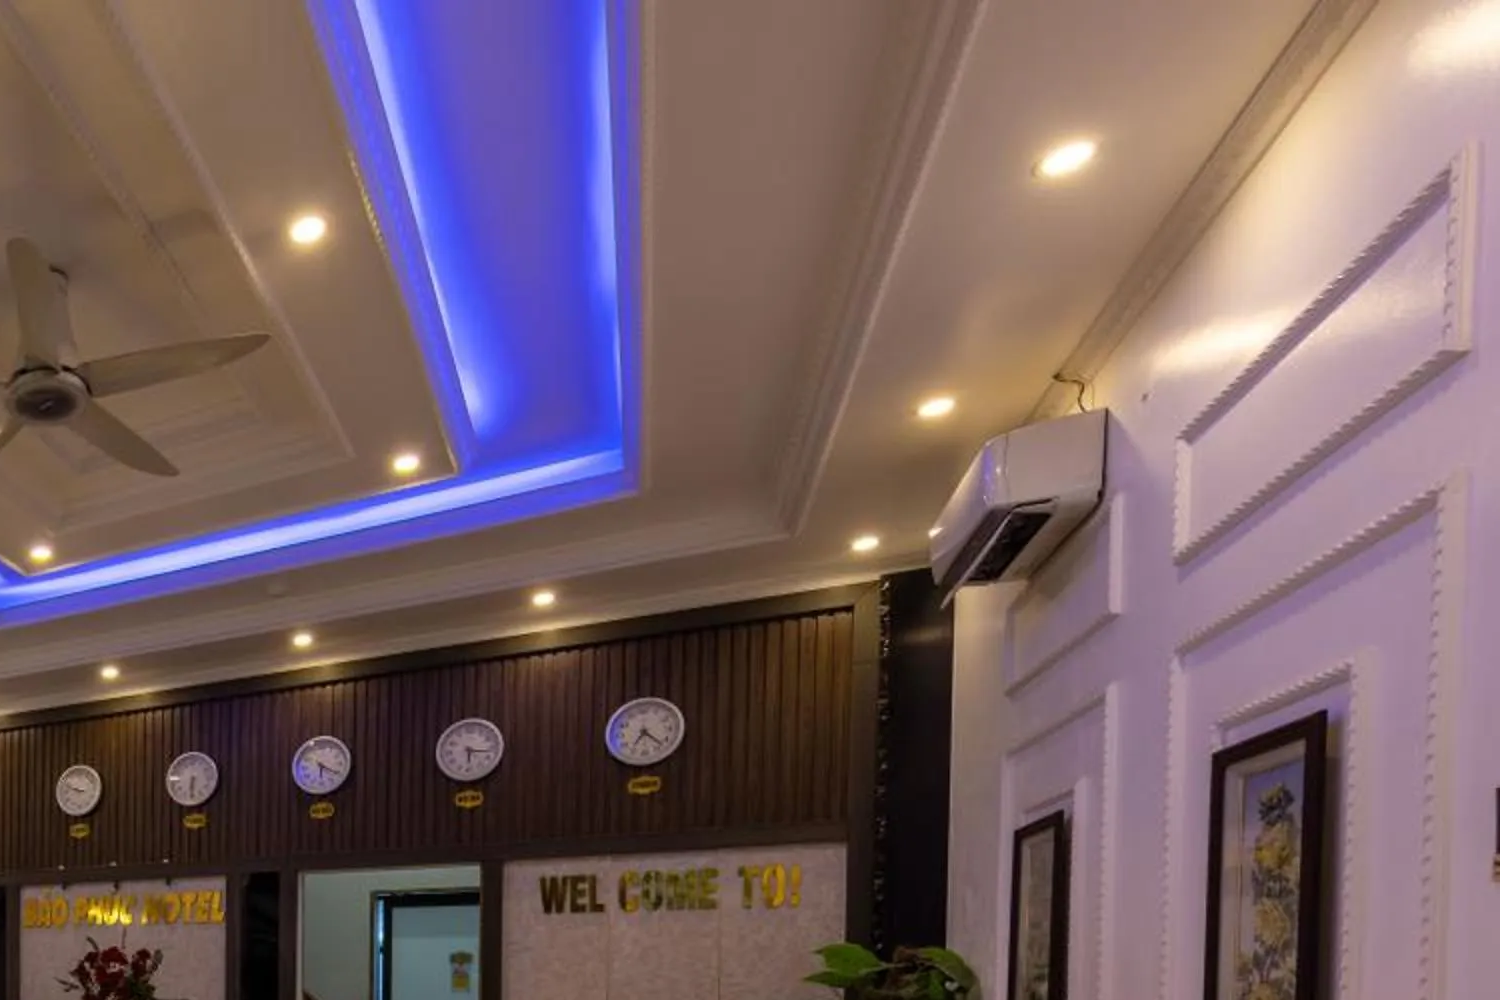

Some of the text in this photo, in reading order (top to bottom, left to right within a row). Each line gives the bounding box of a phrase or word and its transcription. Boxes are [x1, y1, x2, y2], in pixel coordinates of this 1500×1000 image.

[141, 889, 224, 927] HOTEL
[539, 863, 802, 915] WEL COME TO!
